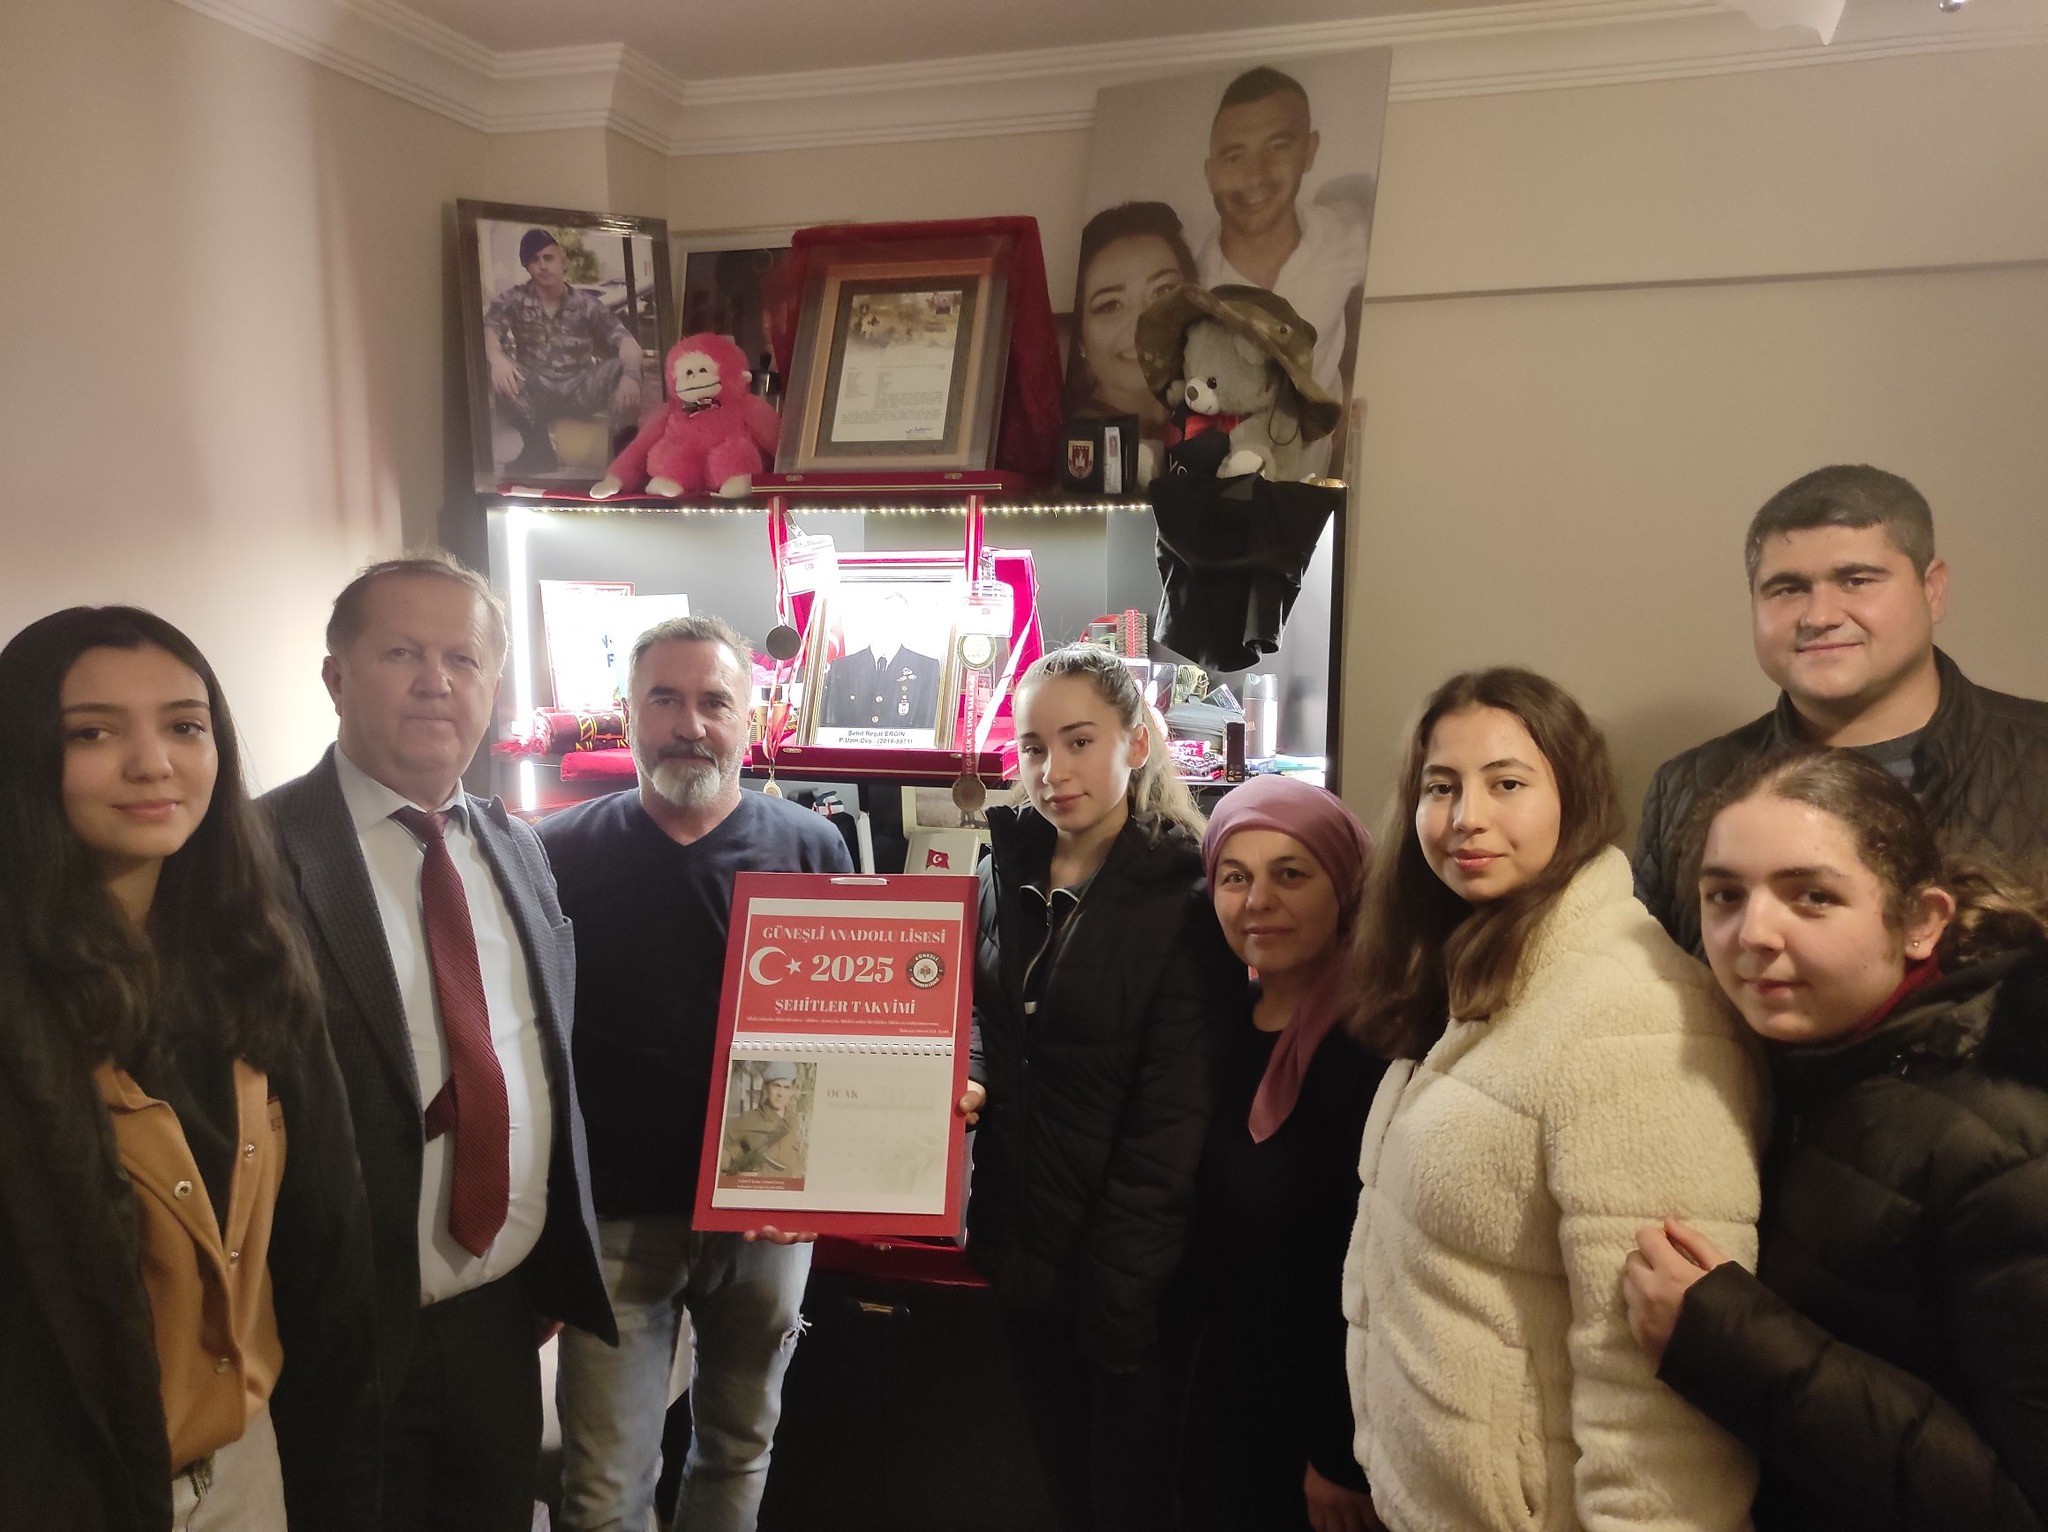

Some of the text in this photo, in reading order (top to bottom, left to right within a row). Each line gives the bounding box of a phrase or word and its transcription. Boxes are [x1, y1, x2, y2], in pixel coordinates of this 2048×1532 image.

[762, 925, 946, 944] GÜNEŞLİ ANADOLU LİSESİ
[810, 954, 894, 983] 2025
[774, 997, 916, 1014] ŞEHİTLER TAKVİMİ
[827, 1089, 859, 1099] OCAK
